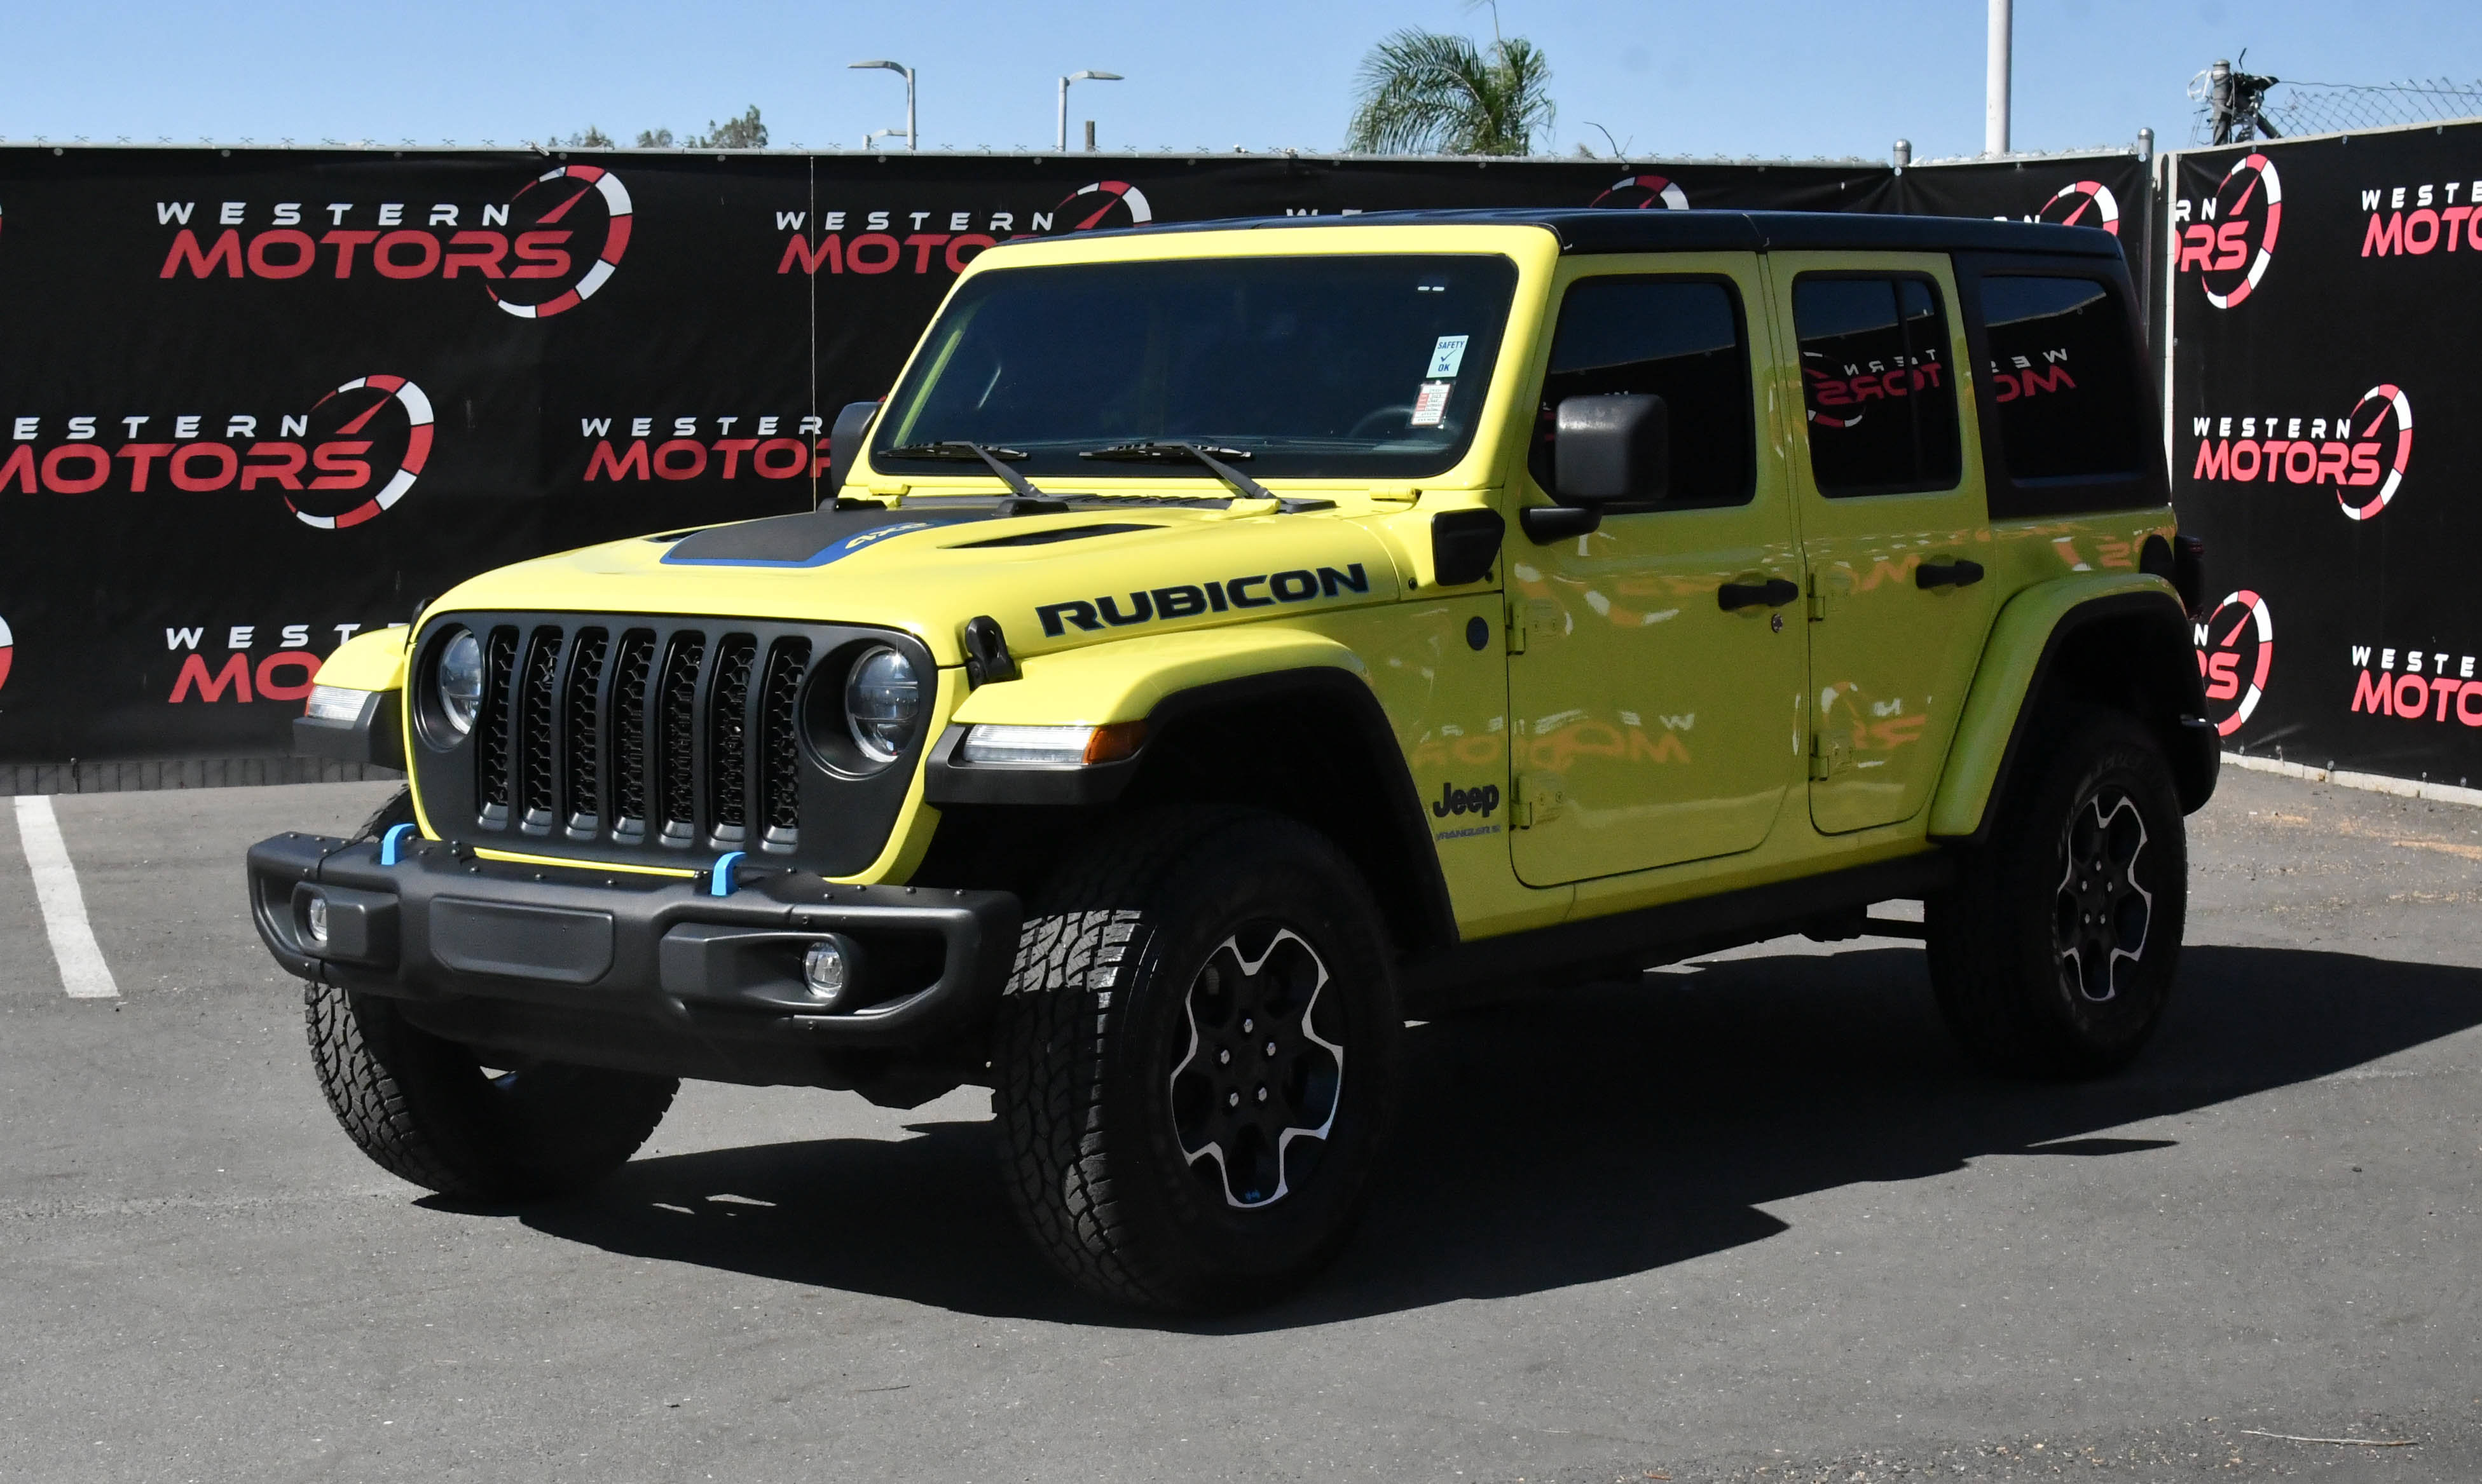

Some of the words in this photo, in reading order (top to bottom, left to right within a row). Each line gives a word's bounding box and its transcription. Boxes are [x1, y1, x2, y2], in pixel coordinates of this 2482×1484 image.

[2175, 197, 2217, 222] RN
[2362, 180, 2482, 212] WESTE
[156, 202, 509, 226] WESTERN
[776, 212, 1054, 232] WESTERN
[160, 229, 573, 279] MOTORS
[777, 233, 1040, 275] MOTO
[2174, 221, 2250, 272] RS
[1437, 340, 1465, 350] SAFETY
[1437, 363, 1451, 372] OK
[13, 414, 308, 440] ESTERN
[581, 416, 823, 437] WESTER
[2193, 417, 2351, 440] WESTERN
[2193, 439, 2382, 486] MOTORS
[1035, 562, 1370, 638] RUBICON
[166, 623, 409, 651] WEST
[168, 651, 324, 704] MO
[2352, 645, 2476, 678] WESTE
[2351, 669, 2482, 727] MOTO
[1432, 782, 1500, 818] Jeep
